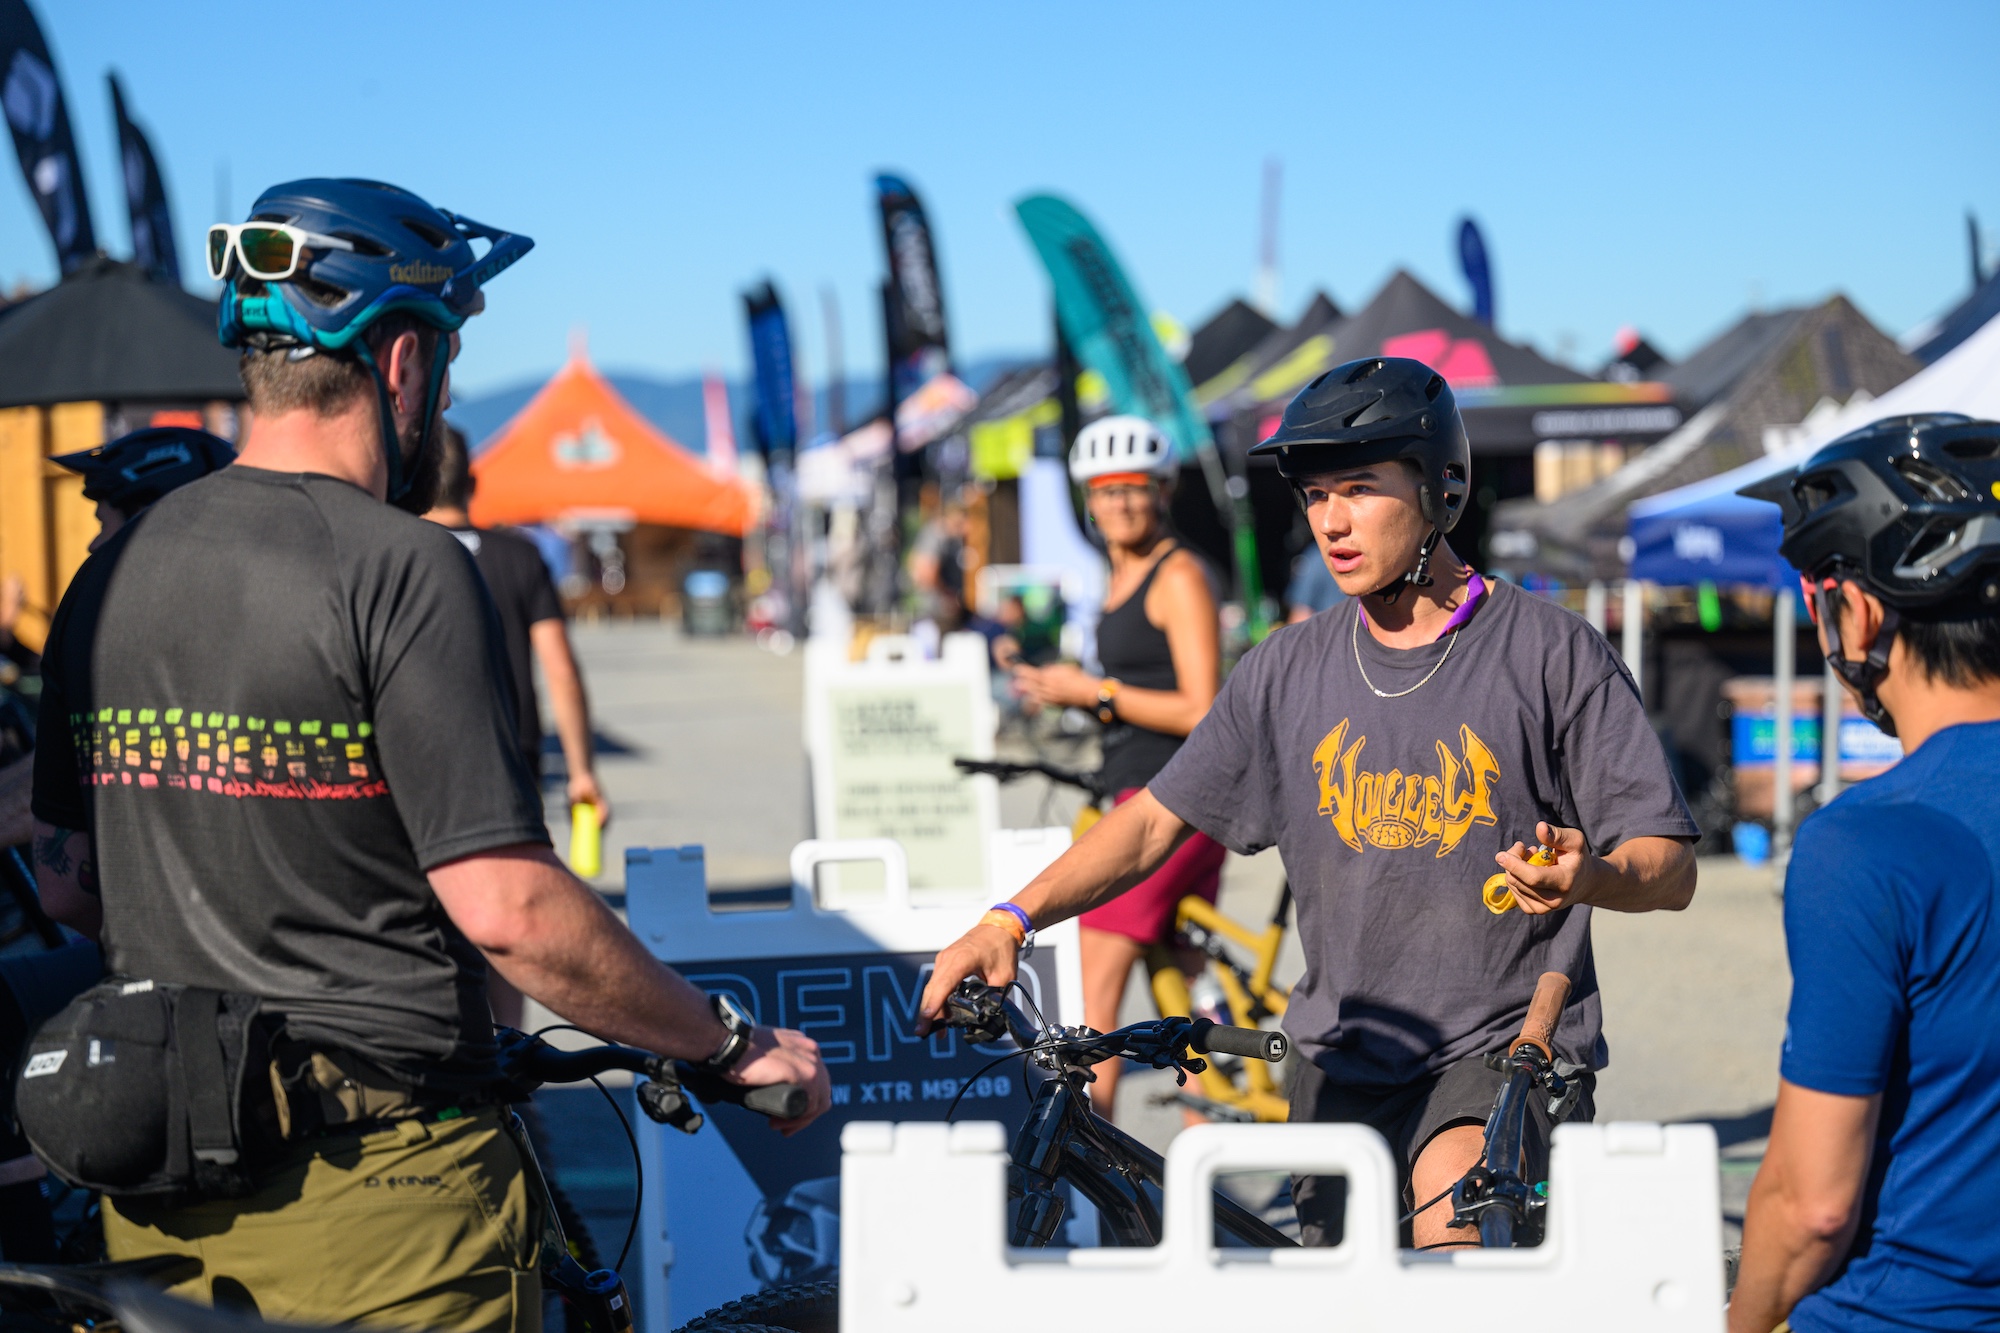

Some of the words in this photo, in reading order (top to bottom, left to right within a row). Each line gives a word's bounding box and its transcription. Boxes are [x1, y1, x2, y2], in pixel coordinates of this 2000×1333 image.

[1371, 824, 1410, 847] FEST
[860, 1080, 914, 1104] XTR
[921, 1074, 1013, 1102] M9200
